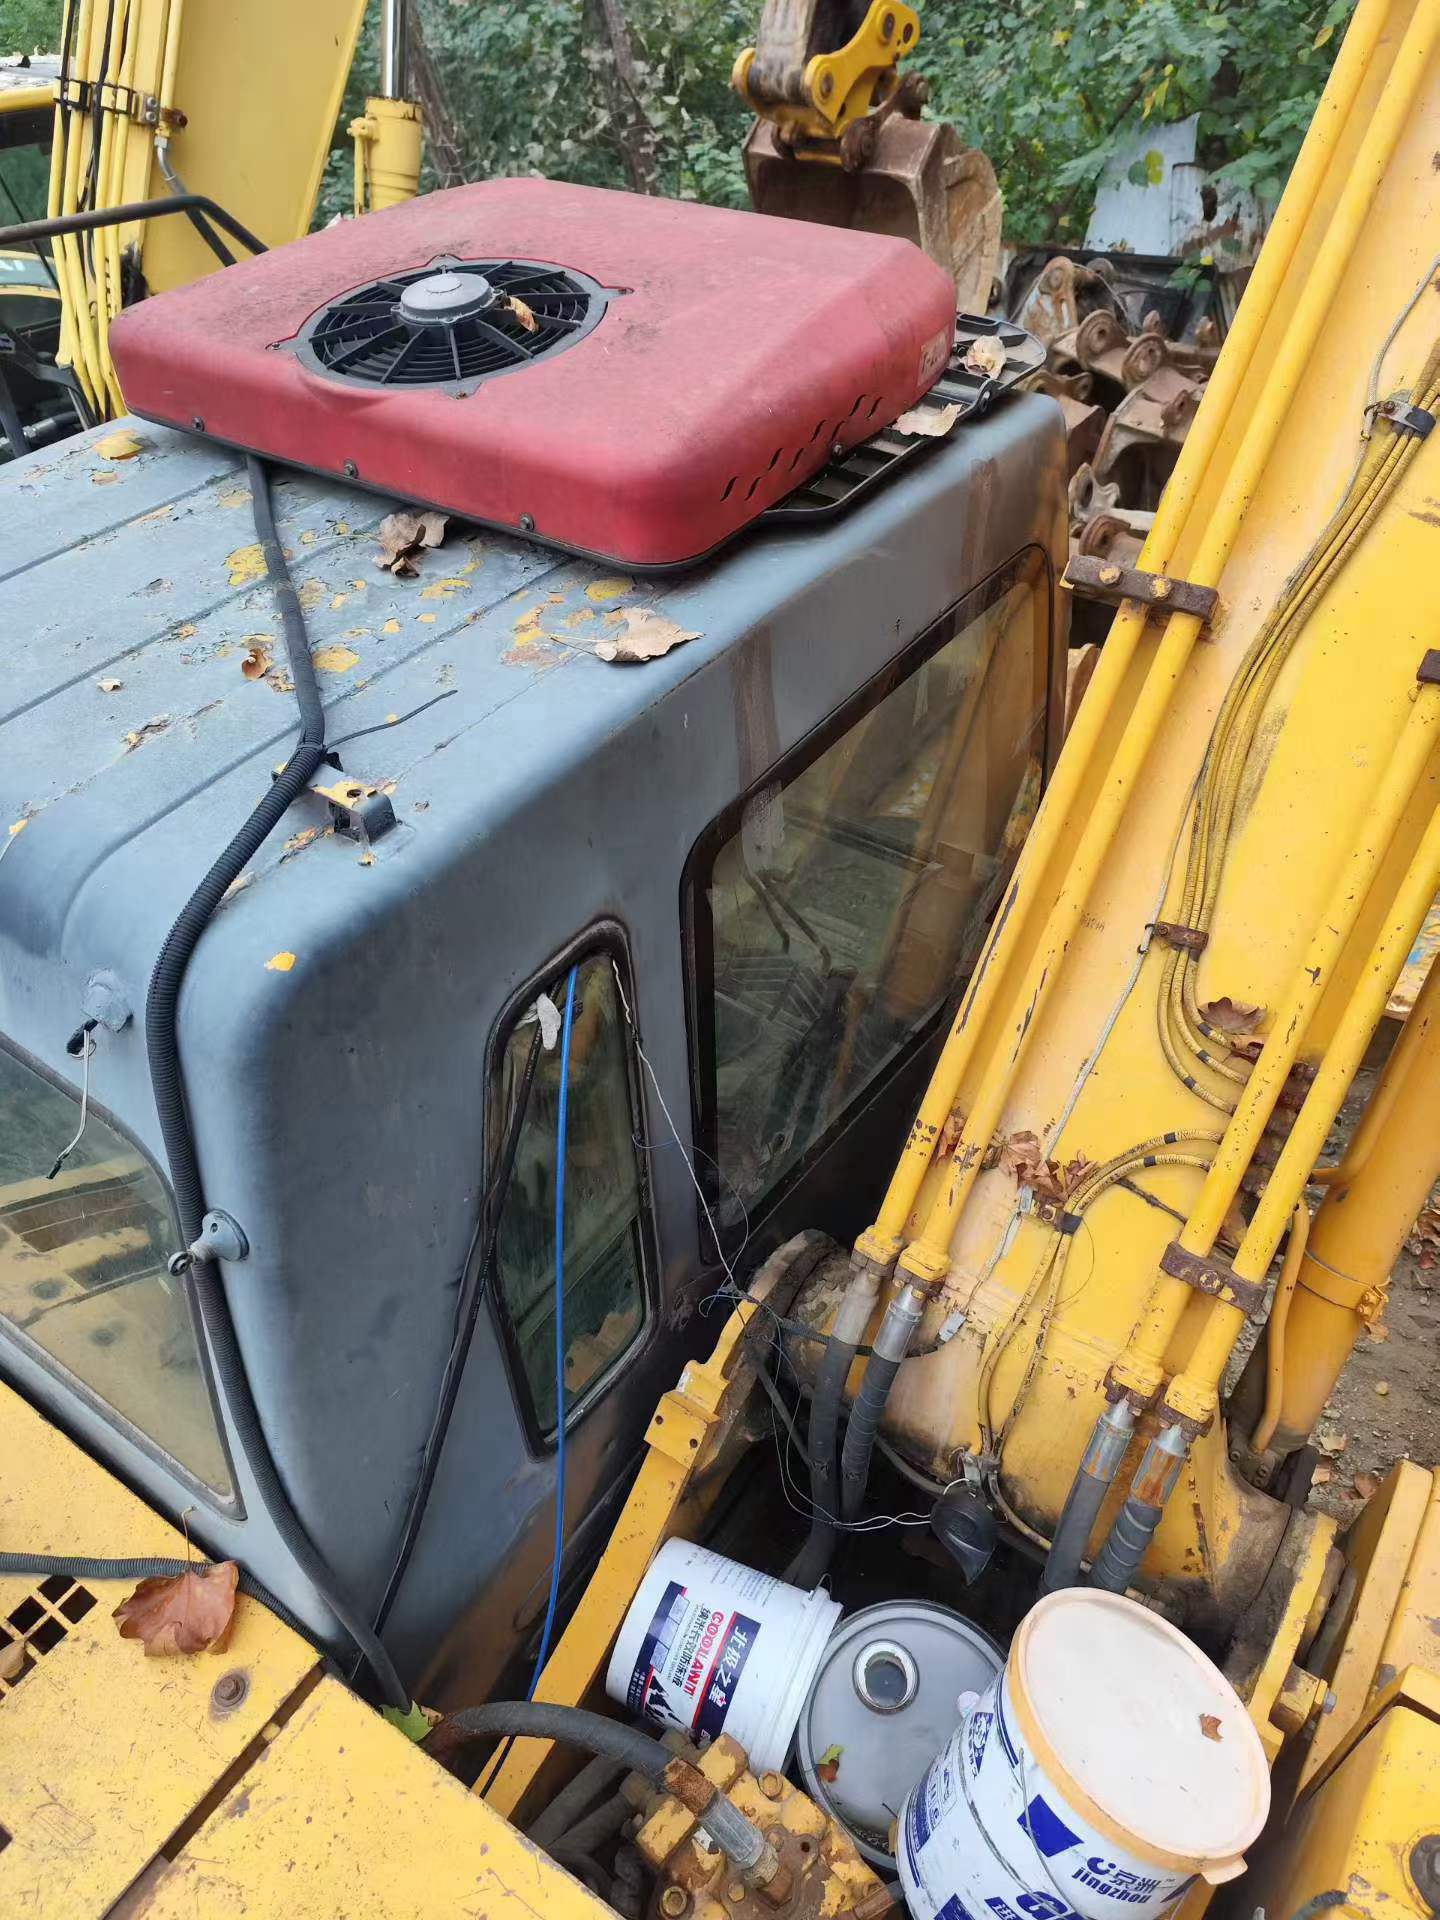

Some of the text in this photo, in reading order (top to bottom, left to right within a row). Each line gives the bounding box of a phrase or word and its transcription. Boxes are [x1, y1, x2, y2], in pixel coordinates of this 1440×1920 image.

[684, 1611, 724, 1697] COOLANT
[709, 1625, 749, 1708] 北极之星
[1071, 1868, 1152, 1904] jingzhou
[1110, 1868, 1162, 1894] 京洲
